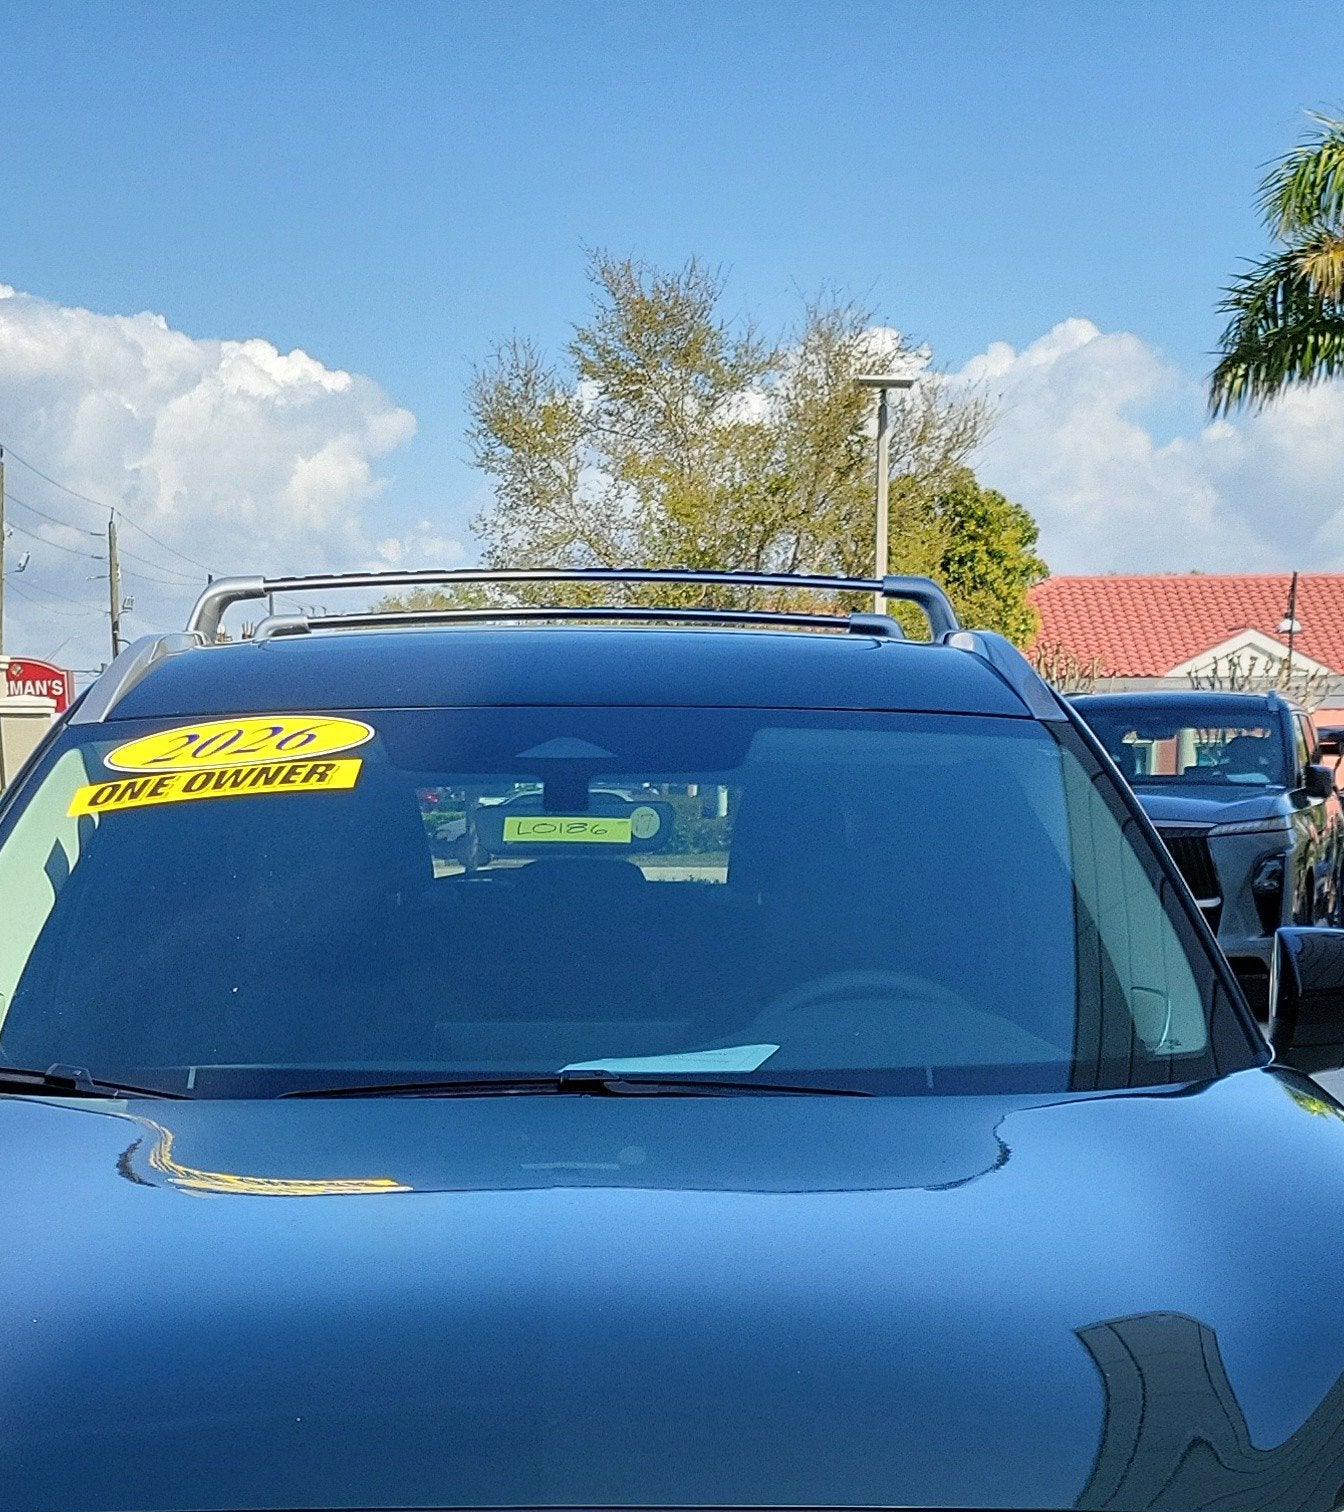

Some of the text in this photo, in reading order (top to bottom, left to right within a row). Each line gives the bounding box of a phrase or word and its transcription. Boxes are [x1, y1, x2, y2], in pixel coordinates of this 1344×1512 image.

[6, 679, 64, 696] MAN'S
[141, 722, 337, 765] 2026
[88, 763, 339, 807] ONE OWNER
